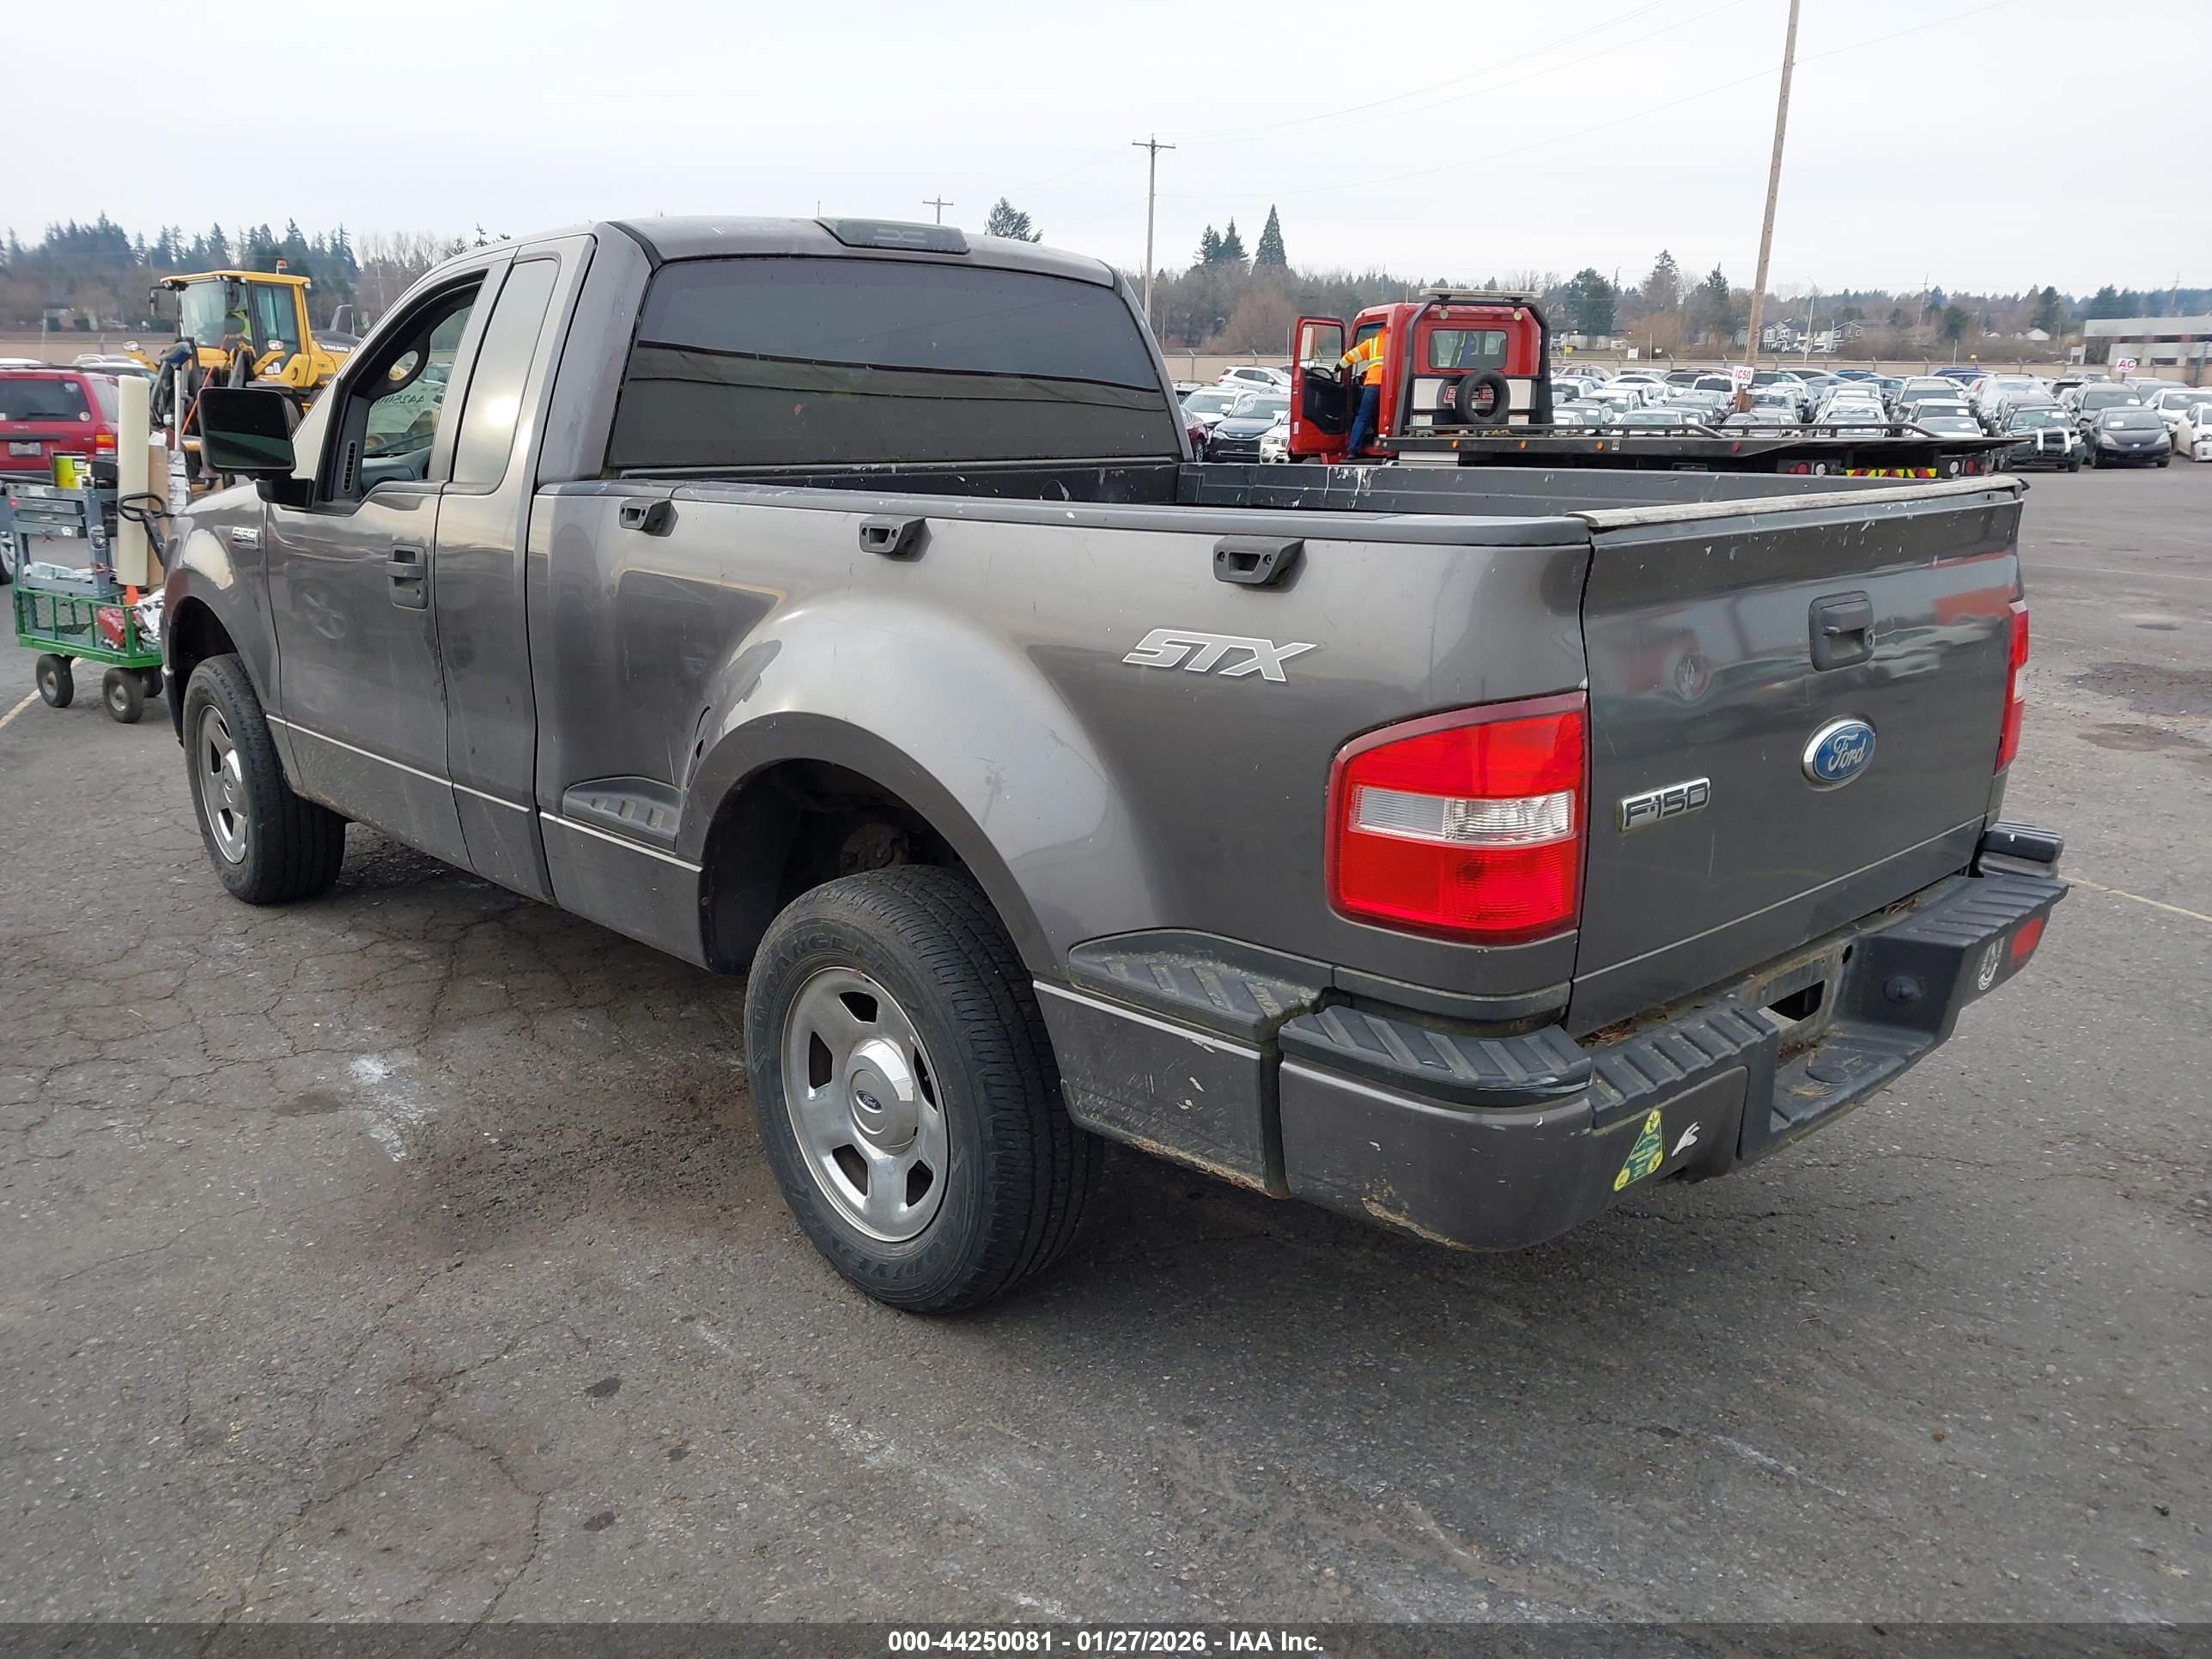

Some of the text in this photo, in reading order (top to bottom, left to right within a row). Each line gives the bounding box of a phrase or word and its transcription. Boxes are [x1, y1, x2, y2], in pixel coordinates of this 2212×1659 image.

[2118, 360, 2136, 368] AC
[1121, 628, 1319, 682] STX
[1827, 732, 1868, 772] Ford
